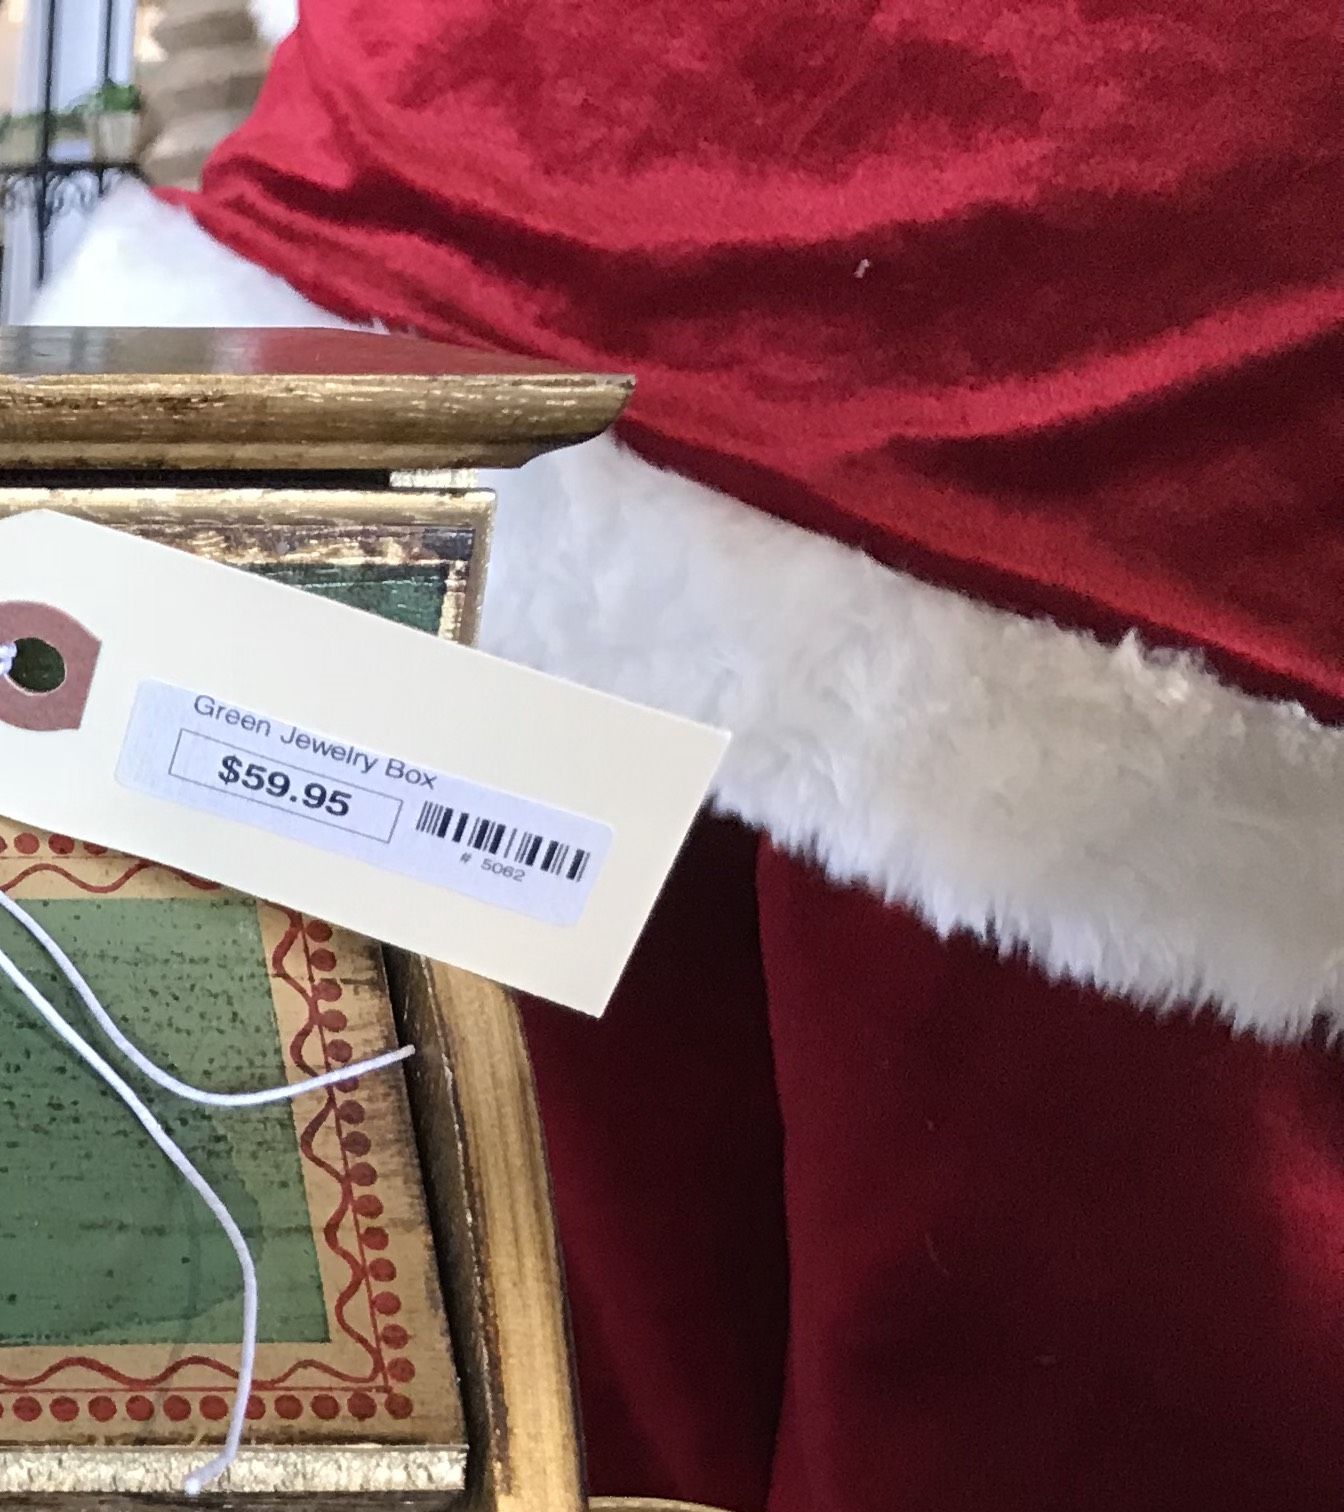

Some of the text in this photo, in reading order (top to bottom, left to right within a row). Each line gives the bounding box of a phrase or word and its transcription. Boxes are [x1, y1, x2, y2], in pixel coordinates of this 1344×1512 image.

[193, 694, 438, 790] Green Jewelry Box
[217, 754, 352, 817] $59.95
[480, 858, 526, 883] 5062
